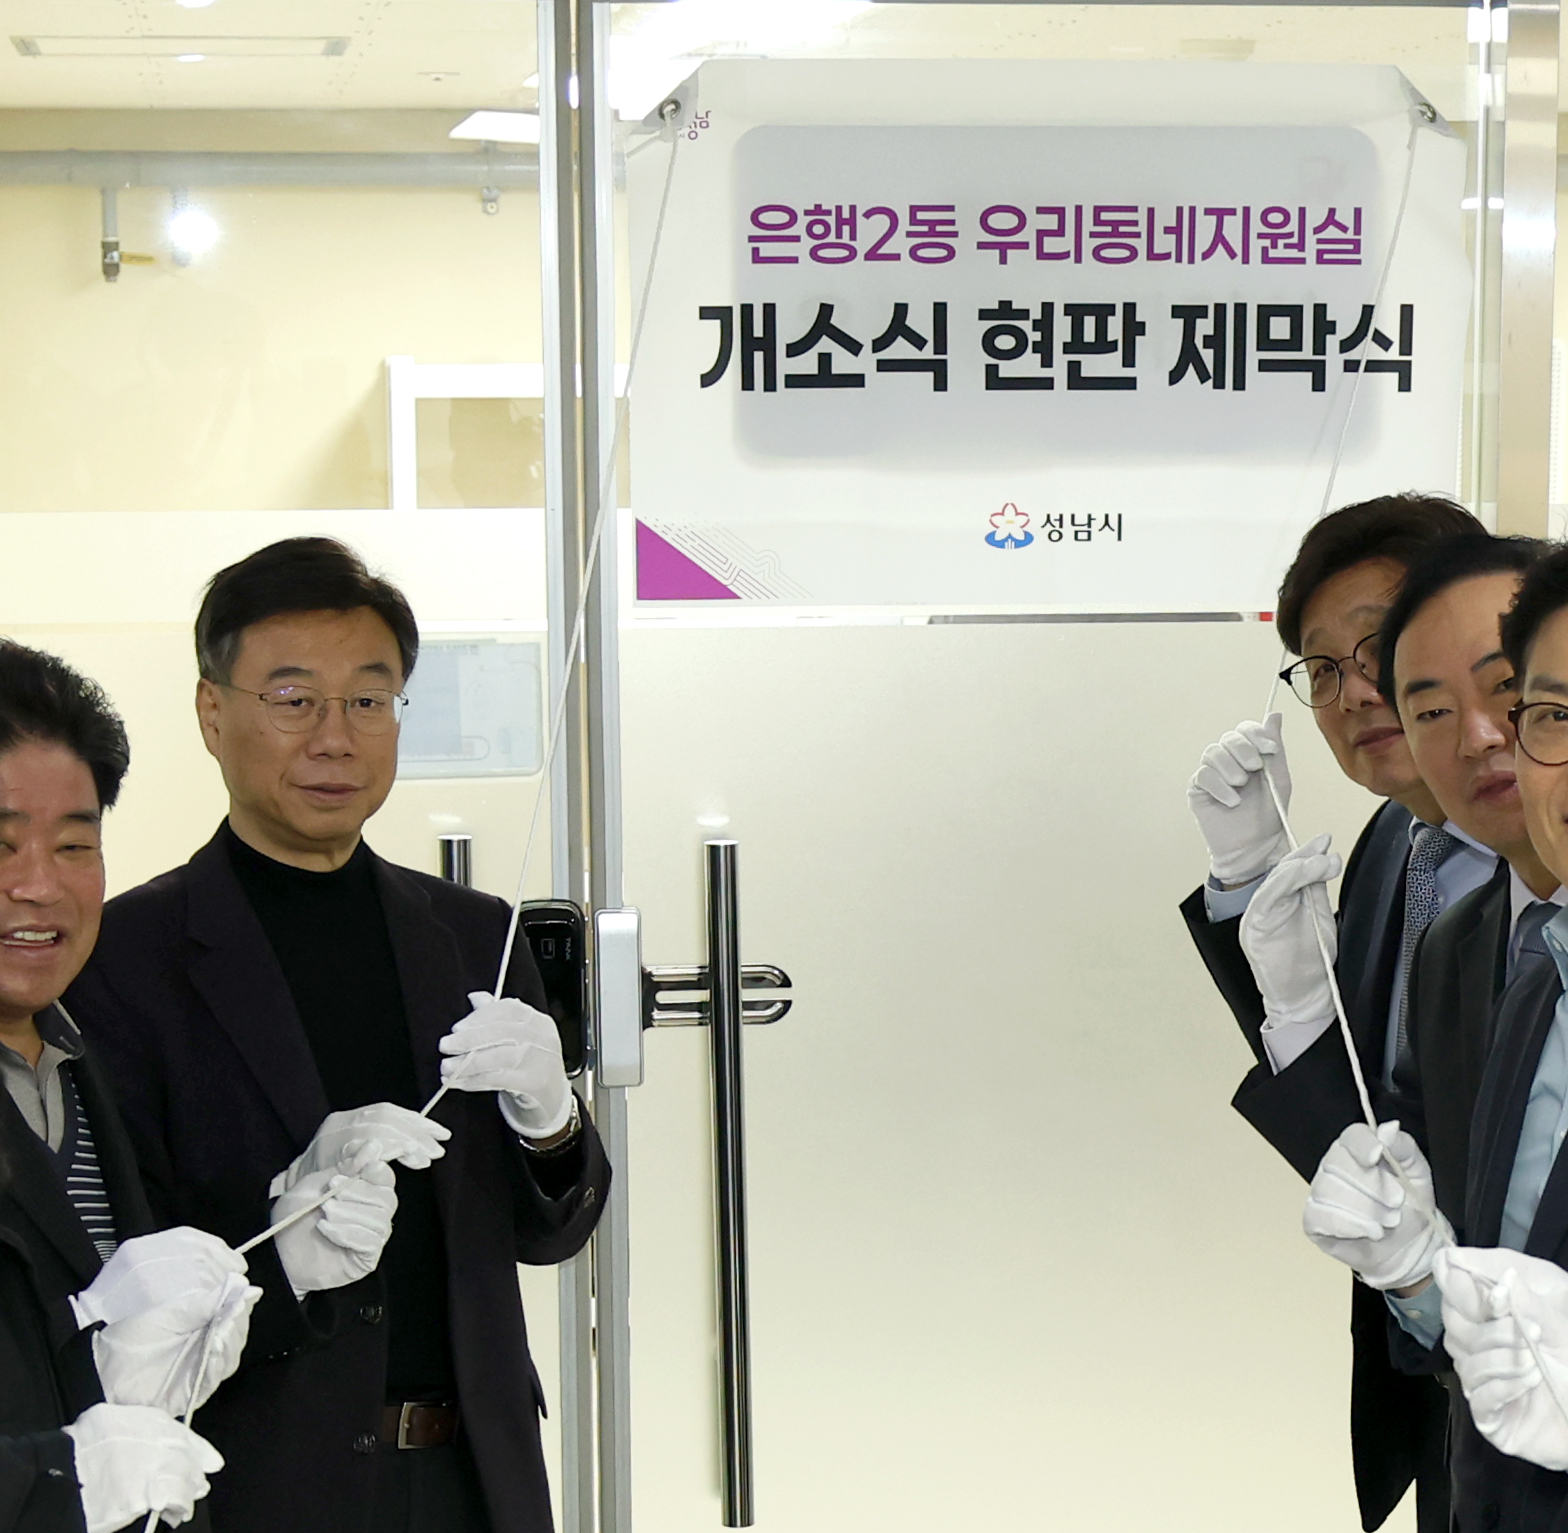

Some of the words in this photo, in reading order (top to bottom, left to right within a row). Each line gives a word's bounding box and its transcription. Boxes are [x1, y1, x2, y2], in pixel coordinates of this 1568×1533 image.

[747, 203, 959, 264] 은행2동
[976, 204, 1363, 265] 우리동네지원실
[698, 301, 949, 393] 개소식
[977, 300, 1147, 392] 현판
[1168, 301, 1415, 393] 제막식
[1040, 513, 1122, 543] 성남시
